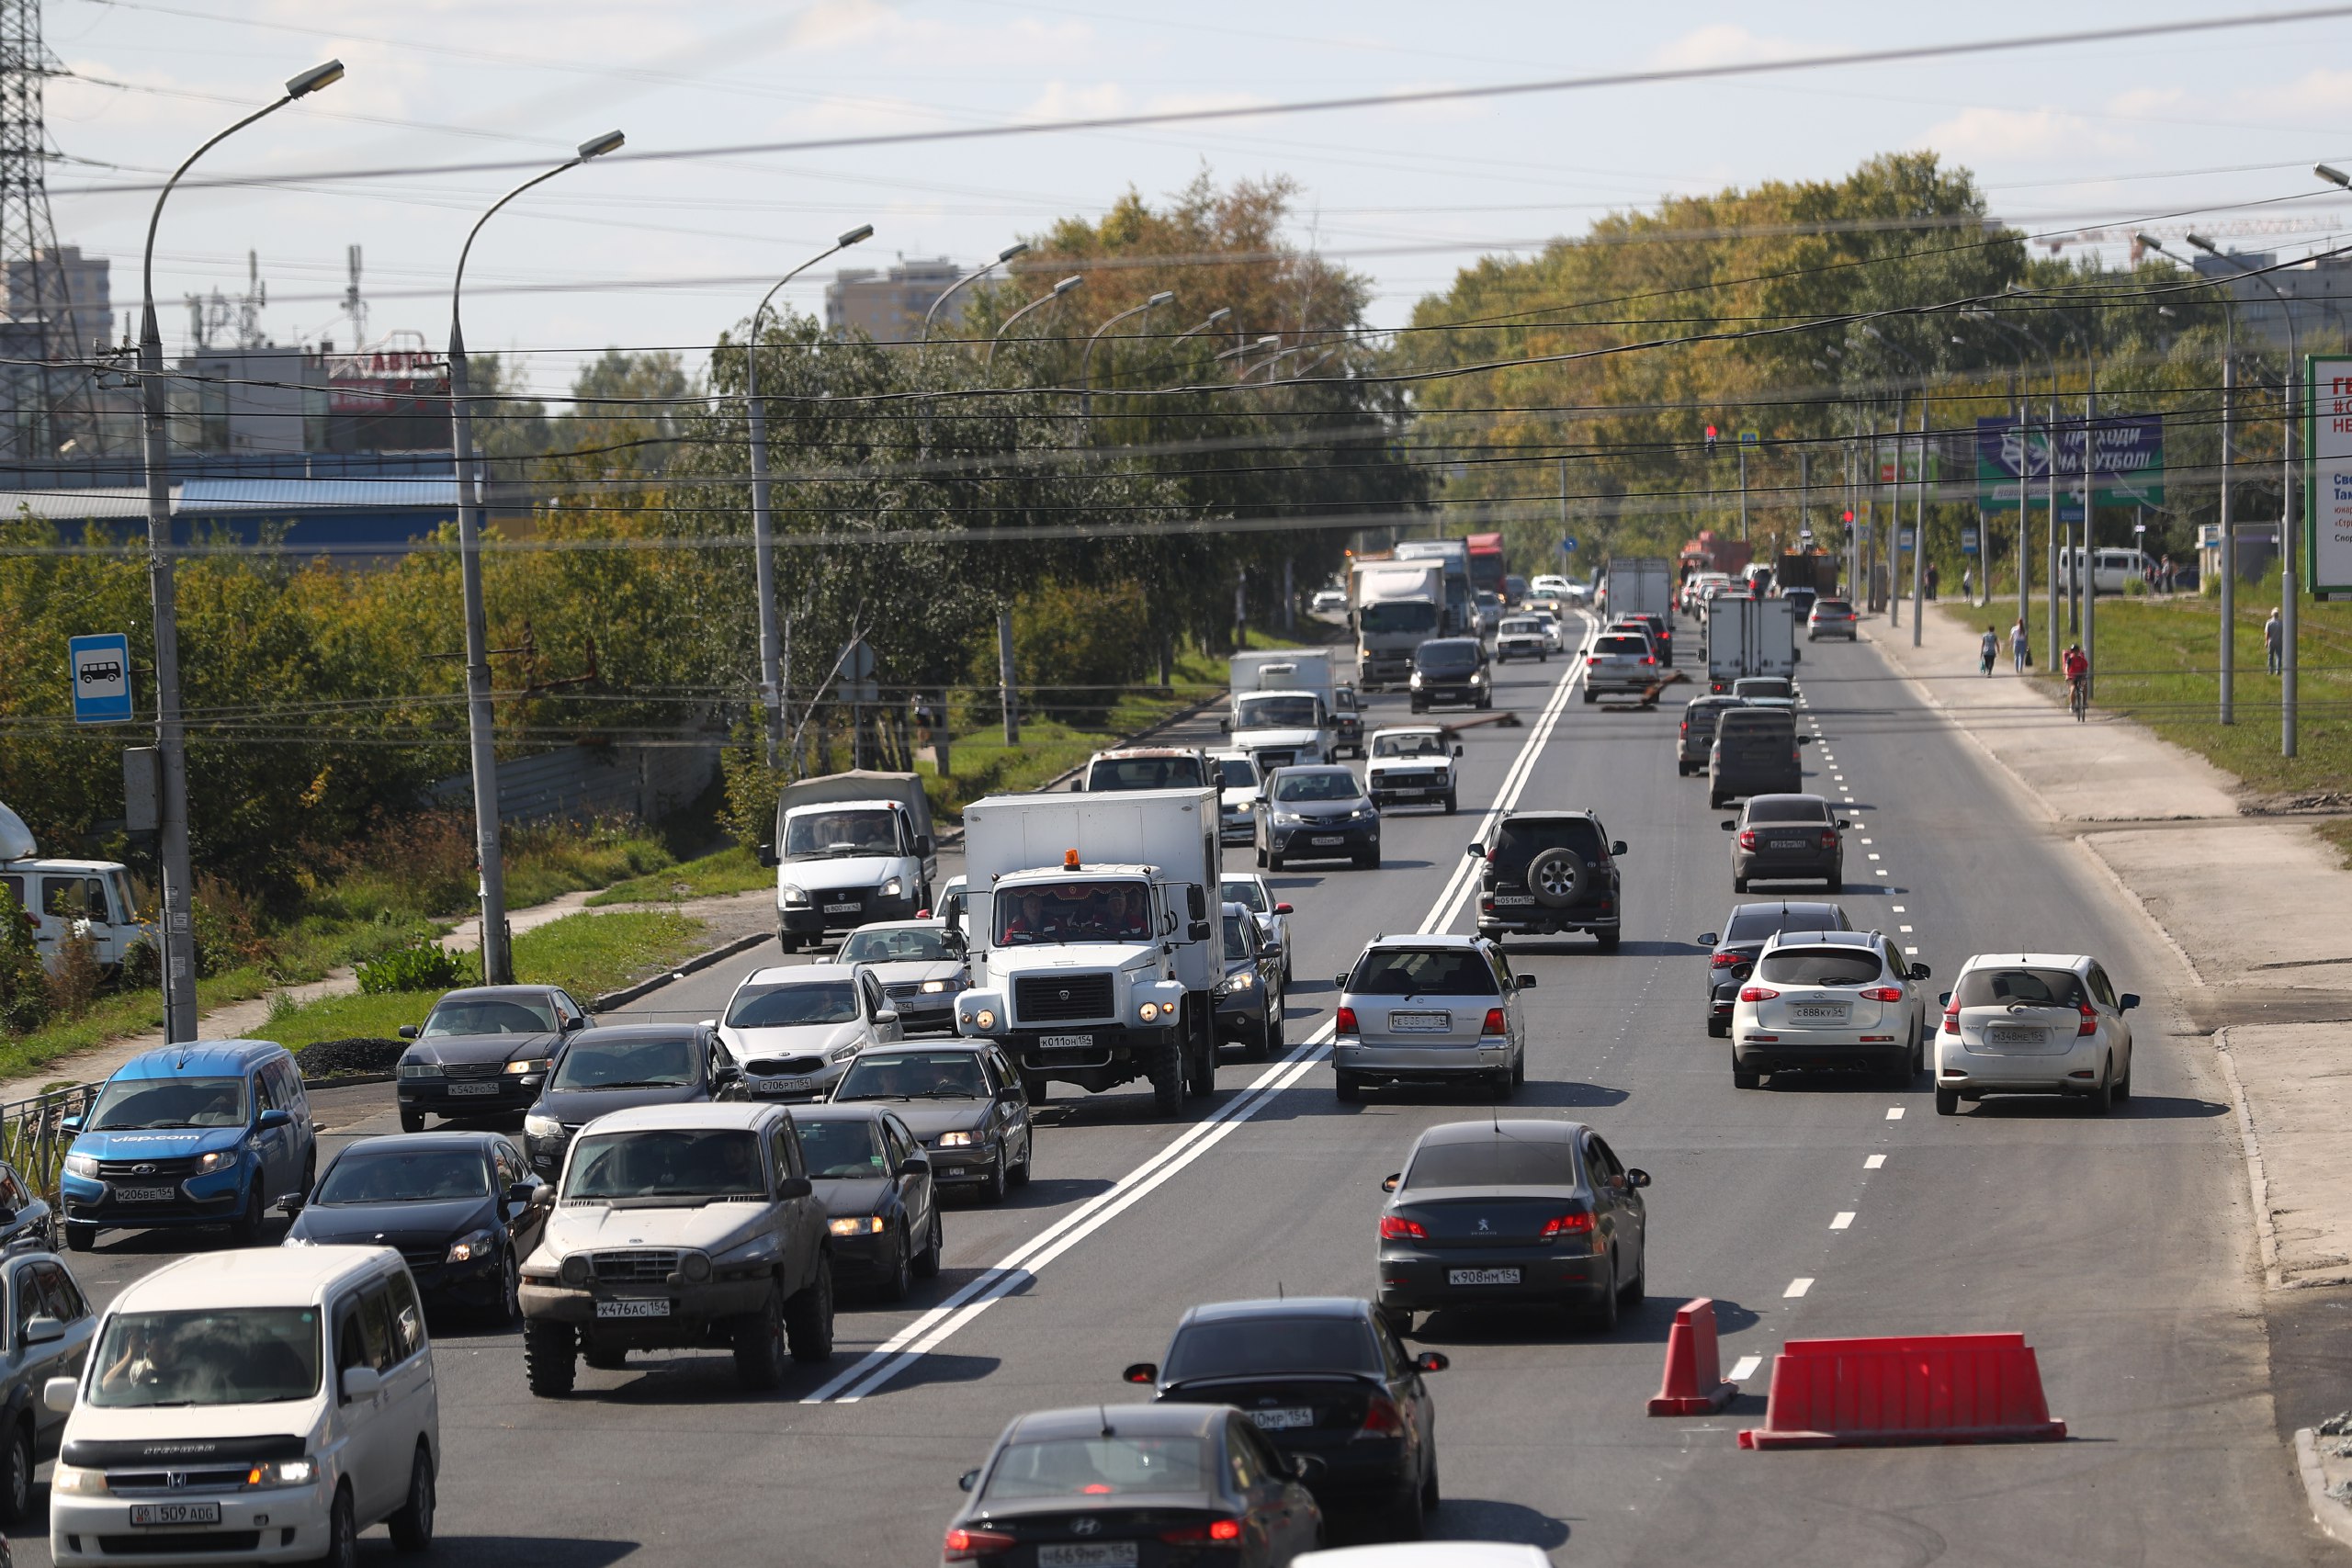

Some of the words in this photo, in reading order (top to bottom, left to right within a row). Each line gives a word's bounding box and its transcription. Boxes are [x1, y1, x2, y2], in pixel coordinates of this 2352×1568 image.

[2064, 427, 2141, 447] ПРХОДИ
[1833, 1007, 1843, 1015] 54
[762, 1080, 794, 1090] С706РТ
[118, 1189, 156, 1200] М206ВЕ
[157, 1187, 173, 1195] 154
[1453, 1271, 1499, 1283] К908НМ
[1500, 1269, 1519, 1280] 154
[601, 1303, 647, 1316] Х476АС
[649, 1302, 667, 1312] 154
[161, 1506, 187, 1521] 509
[190, 1508, 213, 1520] ADG
